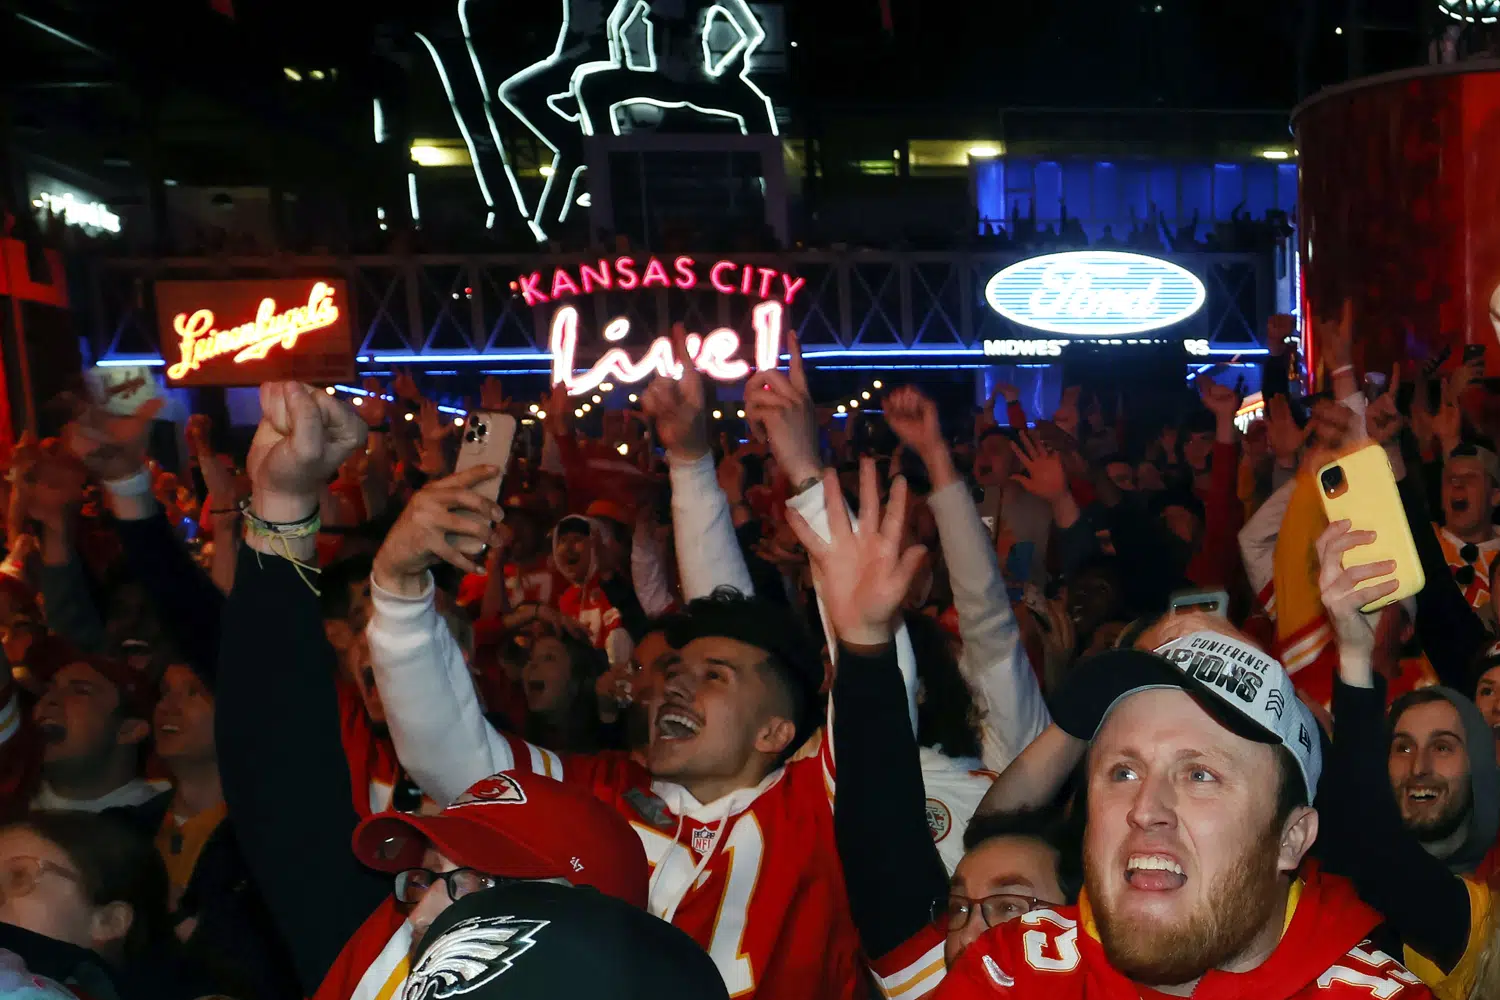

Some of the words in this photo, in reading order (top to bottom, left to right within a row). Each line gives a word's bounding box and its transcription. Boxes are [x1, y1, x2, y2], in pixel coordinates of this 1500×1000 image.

[519, 256, 698, 307] KANSAS
[709, 259, 806, 304] CITY
[1028, 262, 1163, 323] Ford
[1190, 637, 1272, 676] CONFERENCE
